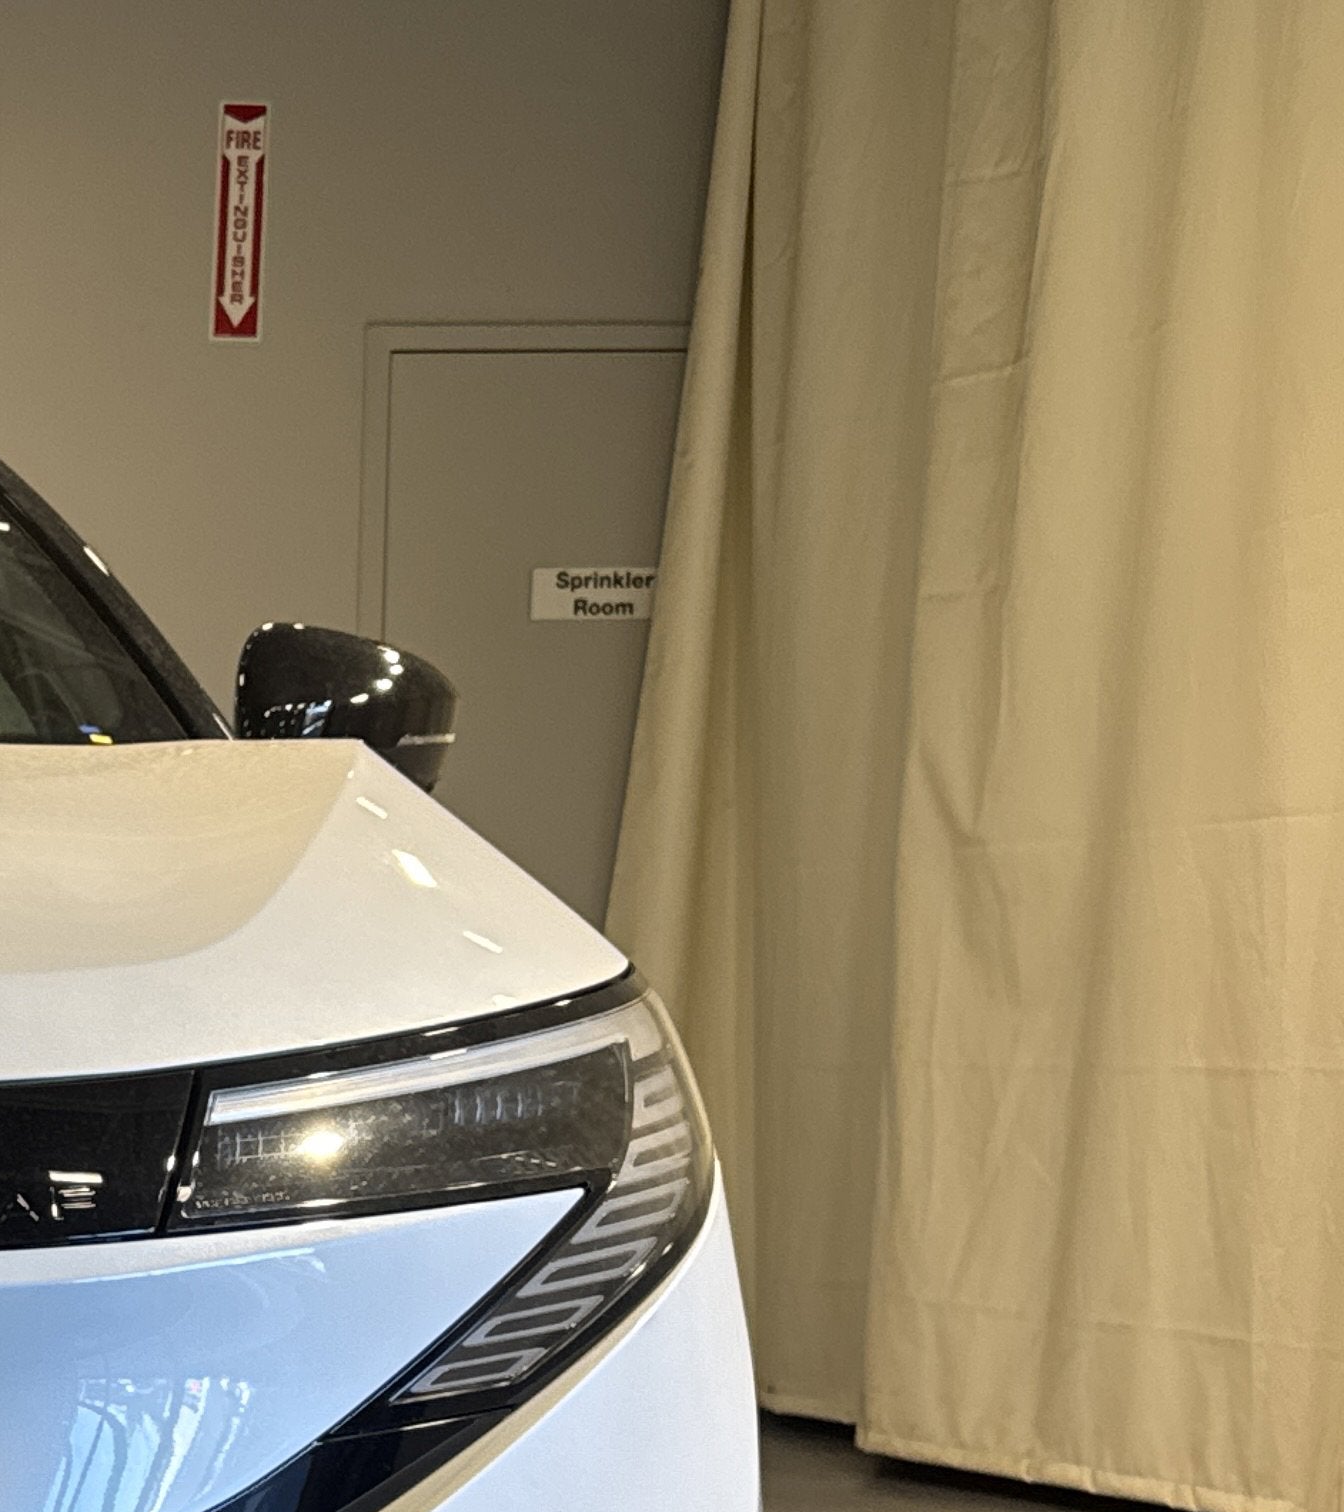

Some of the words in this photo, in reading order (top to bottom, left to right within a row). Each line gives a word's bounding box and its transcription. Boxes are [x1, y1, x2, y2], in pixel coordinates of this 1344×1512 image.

[225, 129, 262, 150] FIRE
[230, 155, 250, 305] EXTINGUISHER
[556, 570, 656, 592] Sprinkler
[573, 598, 634, 616] Room
